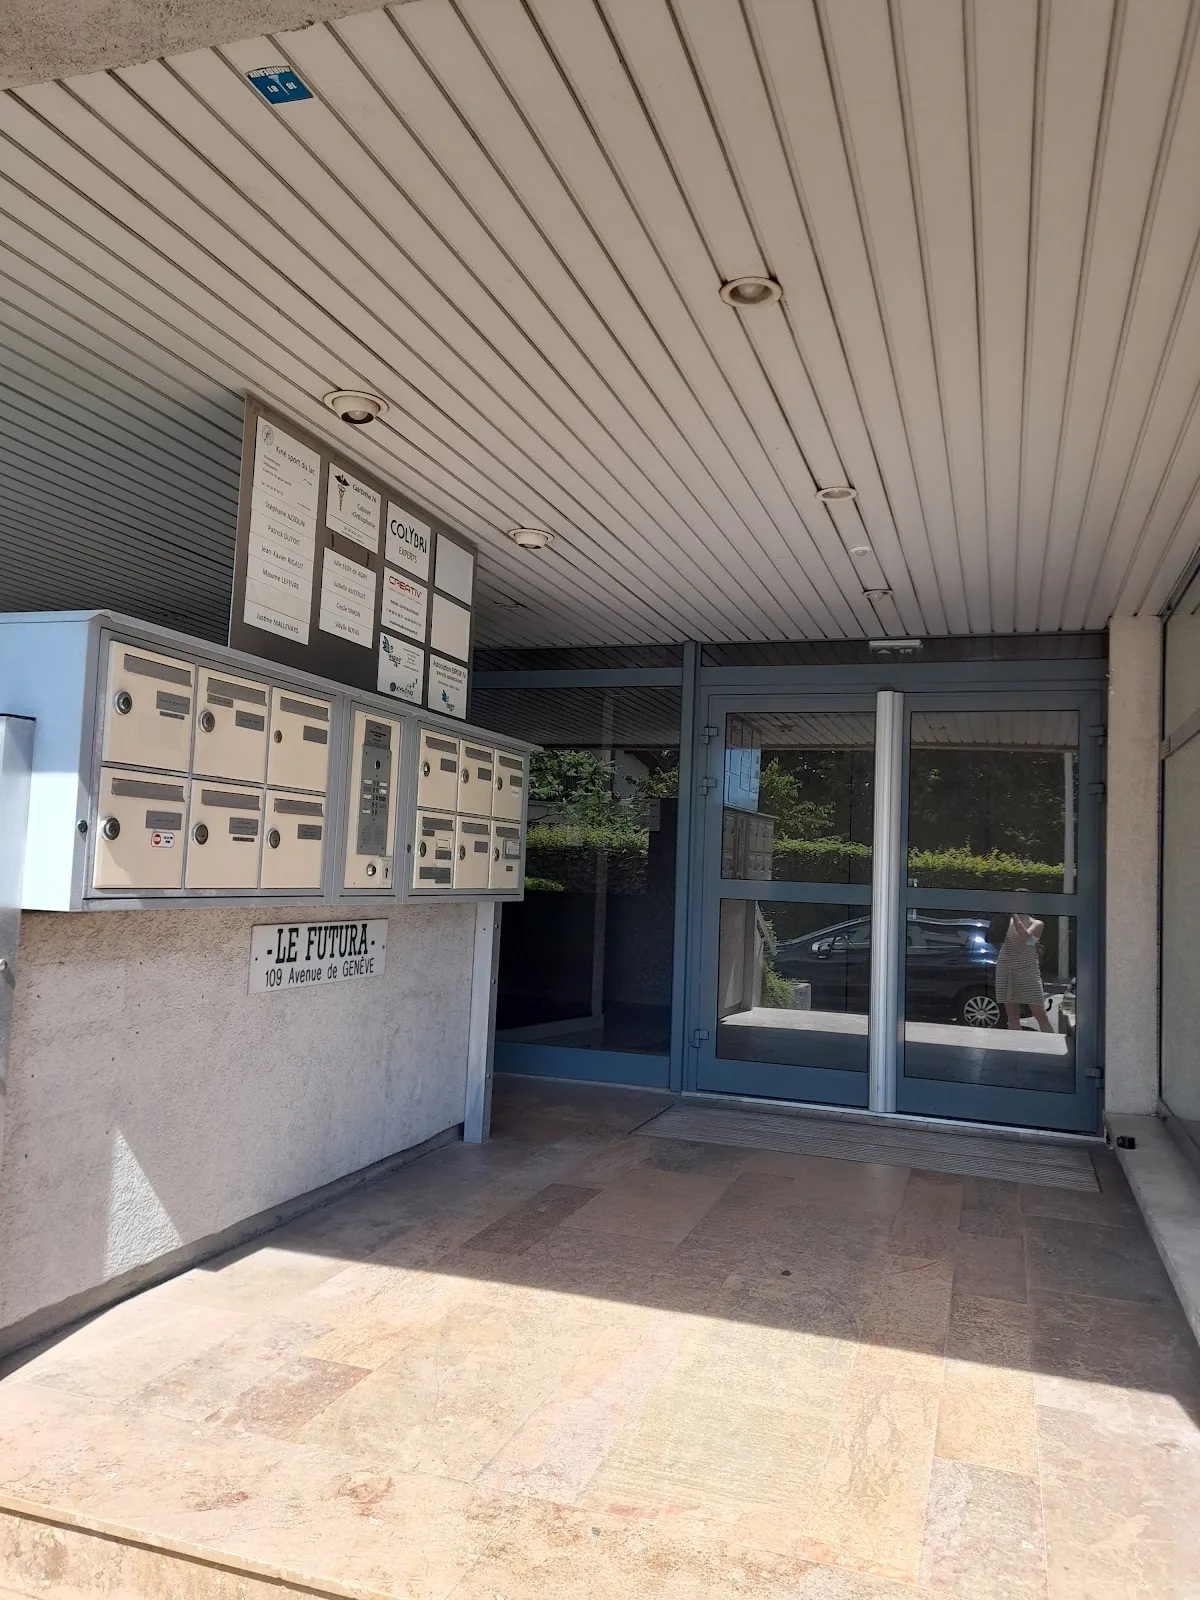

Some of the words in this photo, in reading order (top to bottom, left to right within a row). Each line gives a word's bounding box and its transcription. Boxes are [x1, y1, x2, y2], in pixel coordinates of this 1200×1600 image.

[275, 445, 287, 457] Kiné
[287, 454, 301, 467] sport
[300, 462, 308, 471] du
[308, 464, 317, 476] lac
[267, 524, 284, 538] Patrick
[390, 519, 427, 554] COLYBRI
[398, 546, 418, 564] EXPERTS
[265, 968, 282, 987] 109
[288, 967, 322, 984] Avenue
[327, 963, 338, 979] de
[342, 956, 375, 977] GENÈVE
